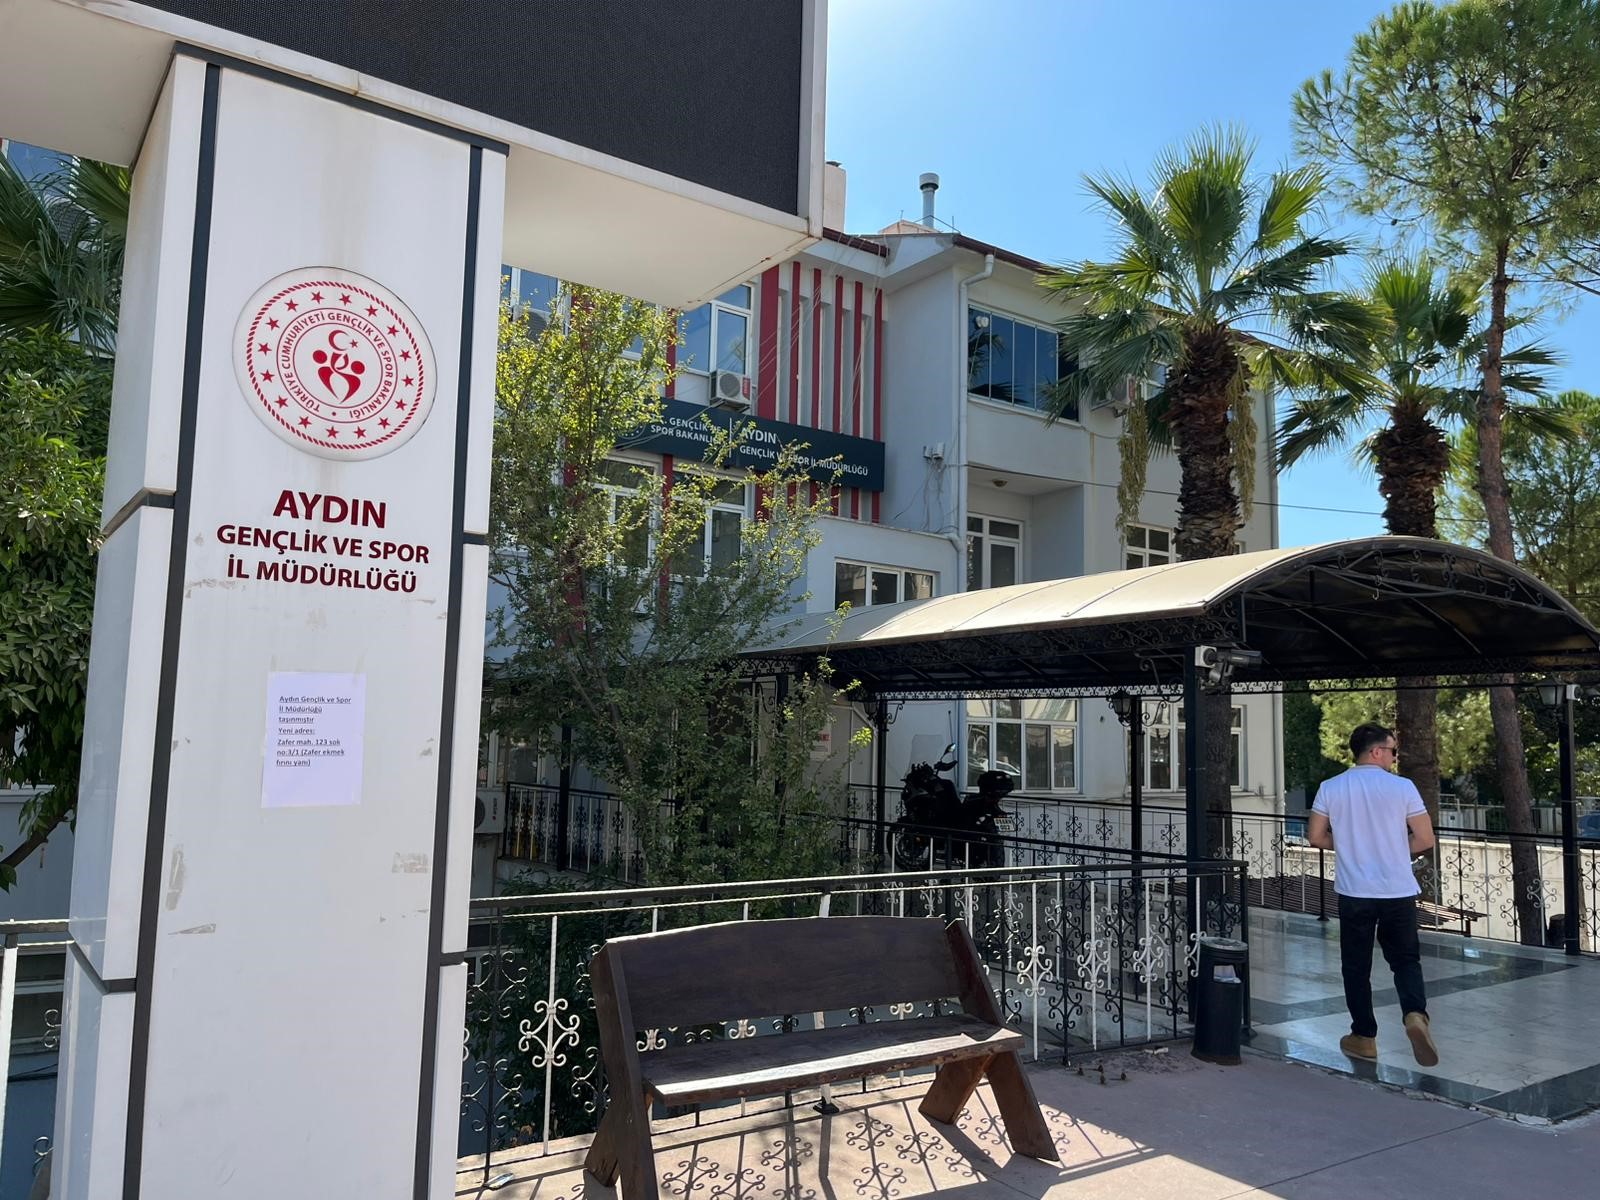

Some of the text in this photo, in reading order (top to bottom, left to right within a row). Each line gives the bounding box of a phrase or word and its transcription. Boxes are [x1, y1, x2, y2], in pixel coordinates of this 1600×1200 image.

[281, 311, 394, 418] TÜRKİYE CUMHURİYETİ GENÇLİK VE SPOR BAKANLIĞI
[650, 424, 674, 436] SPOR
[669, 417, 708, 431] GENÇLİK
[740, 427, 777, 444] AYDIN
[739, 445, 775, 459] GENÇLİK
[272, 489, 386, 529] AYDIN
[216, 524, 429, 564] GENÇLİK VE SPOR
[227, 553, 417, 593] İL MÜDÜRLÜĞÜ
[279, 695, 300, 703] Aydın
[285, 705, 323, 714] Müdürlüğü
[277, 738, 295, 746] Zafer
[315, 738, 328, 746] 123
[329, 738, 341, 746] sok
[301, 748, 321, 757] (Zafer
[322, 748, 345, 756] ekmek
